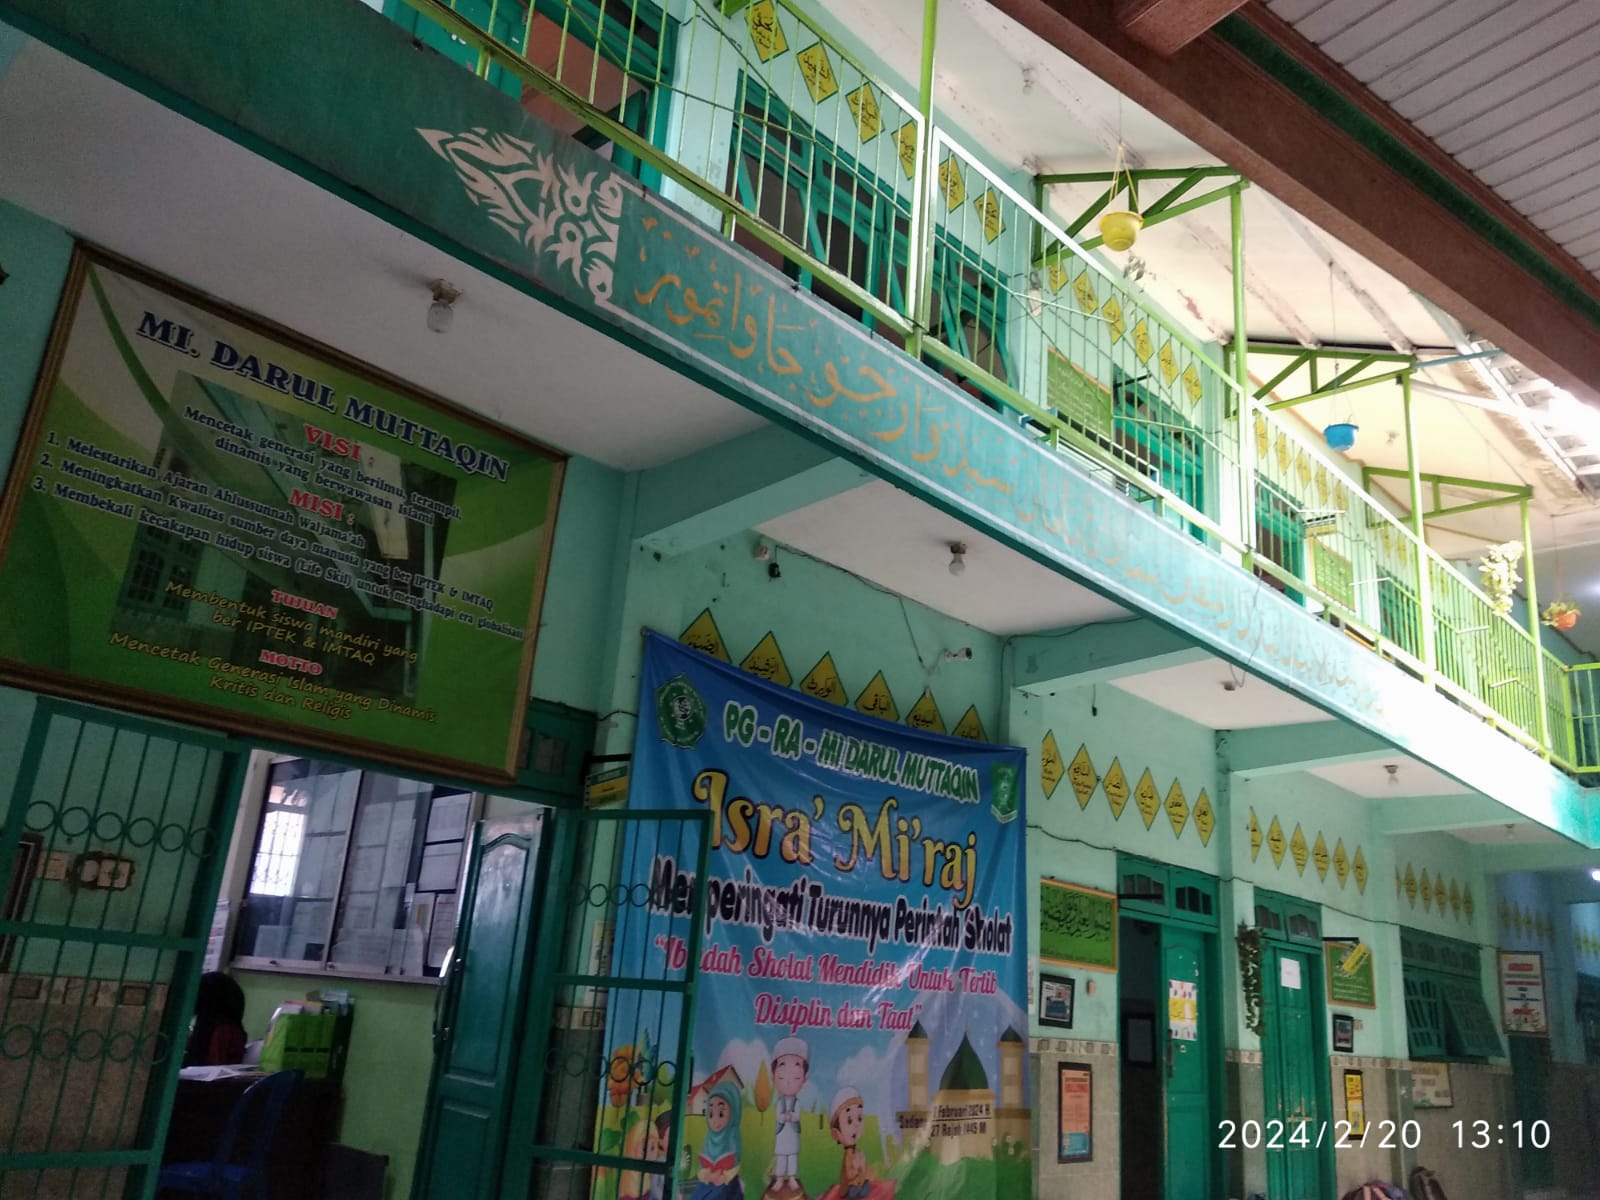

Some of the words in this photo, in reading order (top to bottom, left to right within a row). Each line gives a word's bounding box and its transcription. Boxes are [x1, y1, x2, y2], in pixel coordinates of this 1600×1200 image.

[136, 311, 200, 358] MI.
[209, 340, 337, 414] DARUL
[344, 397, 510, 480] MUTTAQIN
[48, 432, 60, 446] 1.
[67, 437, 158, 479] Melestarikan
[162, 471, 208, 496] Ajaran
[214, 488, 295, 524] Ahlussunnah
[185, 406, 254, 441] Mencetak
[259, 437, 315, 464] generasi
[320, 459, 352, 480] yang
[356, 471, 406, 500] berilmu,
[411, 493, 462, 520] terampil,
[215, 437, 271, 465] dinamis
[278, 461, 310, 482] yang
[315, 473, 393, 510] berwawasan
[398, 503, 434, 526] Islami
[304, 424, 361, 461] VISI
[40, 453, 54, 468] 2.
[60, 459, 163, 502] Meningkatkan
[167, 494, 225, 523] Kwalitas
[230, 515, 276, 538] sumber
[280, 531, 308, 553] daya
[311, 541, 361, 567] manusia
[363, 558, 391, 579] yang
[392, 567, 412, 583] ber
[413, 574, 445, 594] IPTEK
[461, 590, 495, 612] IMTAQ
[289, 489, 344, 521] MISI
[33, 476, 46, 492] 3.
[54, 483, 134, 518] Membekali
[139, 508, 210, 541] kecakapan
[215, 533, 254, 559] hidup
[256, 547, 292, 568] siswa
[294, 556, 323, 578] (Life
[325, 567, 353, 589] Skil)
[357, 578, 392, 599] untuk
[393, 591, 455, 619] menghadapi
[458, 610, 475, 624] era
[165, 581, 267, 619] Membentuk
[271, 612, 314, 631] siswa
[319, 626, 381, 650] mandiri
[383, 644, 418, 664] yang
[212, 611, 242, 627] ber
[246, 621, 297, 644] IPTEK
[303, 637, 316, 649] &
[322, 641, 376, 667] IMTAQ
[272, 589, 338, 620] TUJUAN
[109, 632, 201, 665] Mencetak
[207, 656, 283, 684] Generasi
[288, 675, 329, 696] Islam
[331, 689, 372, 710] yang
[377, 698, 437, 722] Dinamis
[209, 675, 259, 698] Kritis
[263, 688, 295, 705] dan
[302, 698, 352, 720] Religis
[259, 649, 323, 676] MOTTO
[723, 701, 758, 747] PG
[771, 713, 803, 760] RA
[816, 729, 844, 771] MI
[844, 736, 900, 783] DARUL
[900, 751, 980, 803] MUTTAQIN
[650, 856, 808, 943] Meperingati
[808, 882, 892, 955] Turunnya
[893, 894, 960, 950] Perintah
[963, 904, 1013, 956] Sholat
[749, 946, 813, 982] Sholat
[909, 962, 955, 992] Untuk
[958, 966, 997, 995] Tertib
[754, 992, 832, 1033] Disiplin
[836, 1000, 873, 1029] dan
